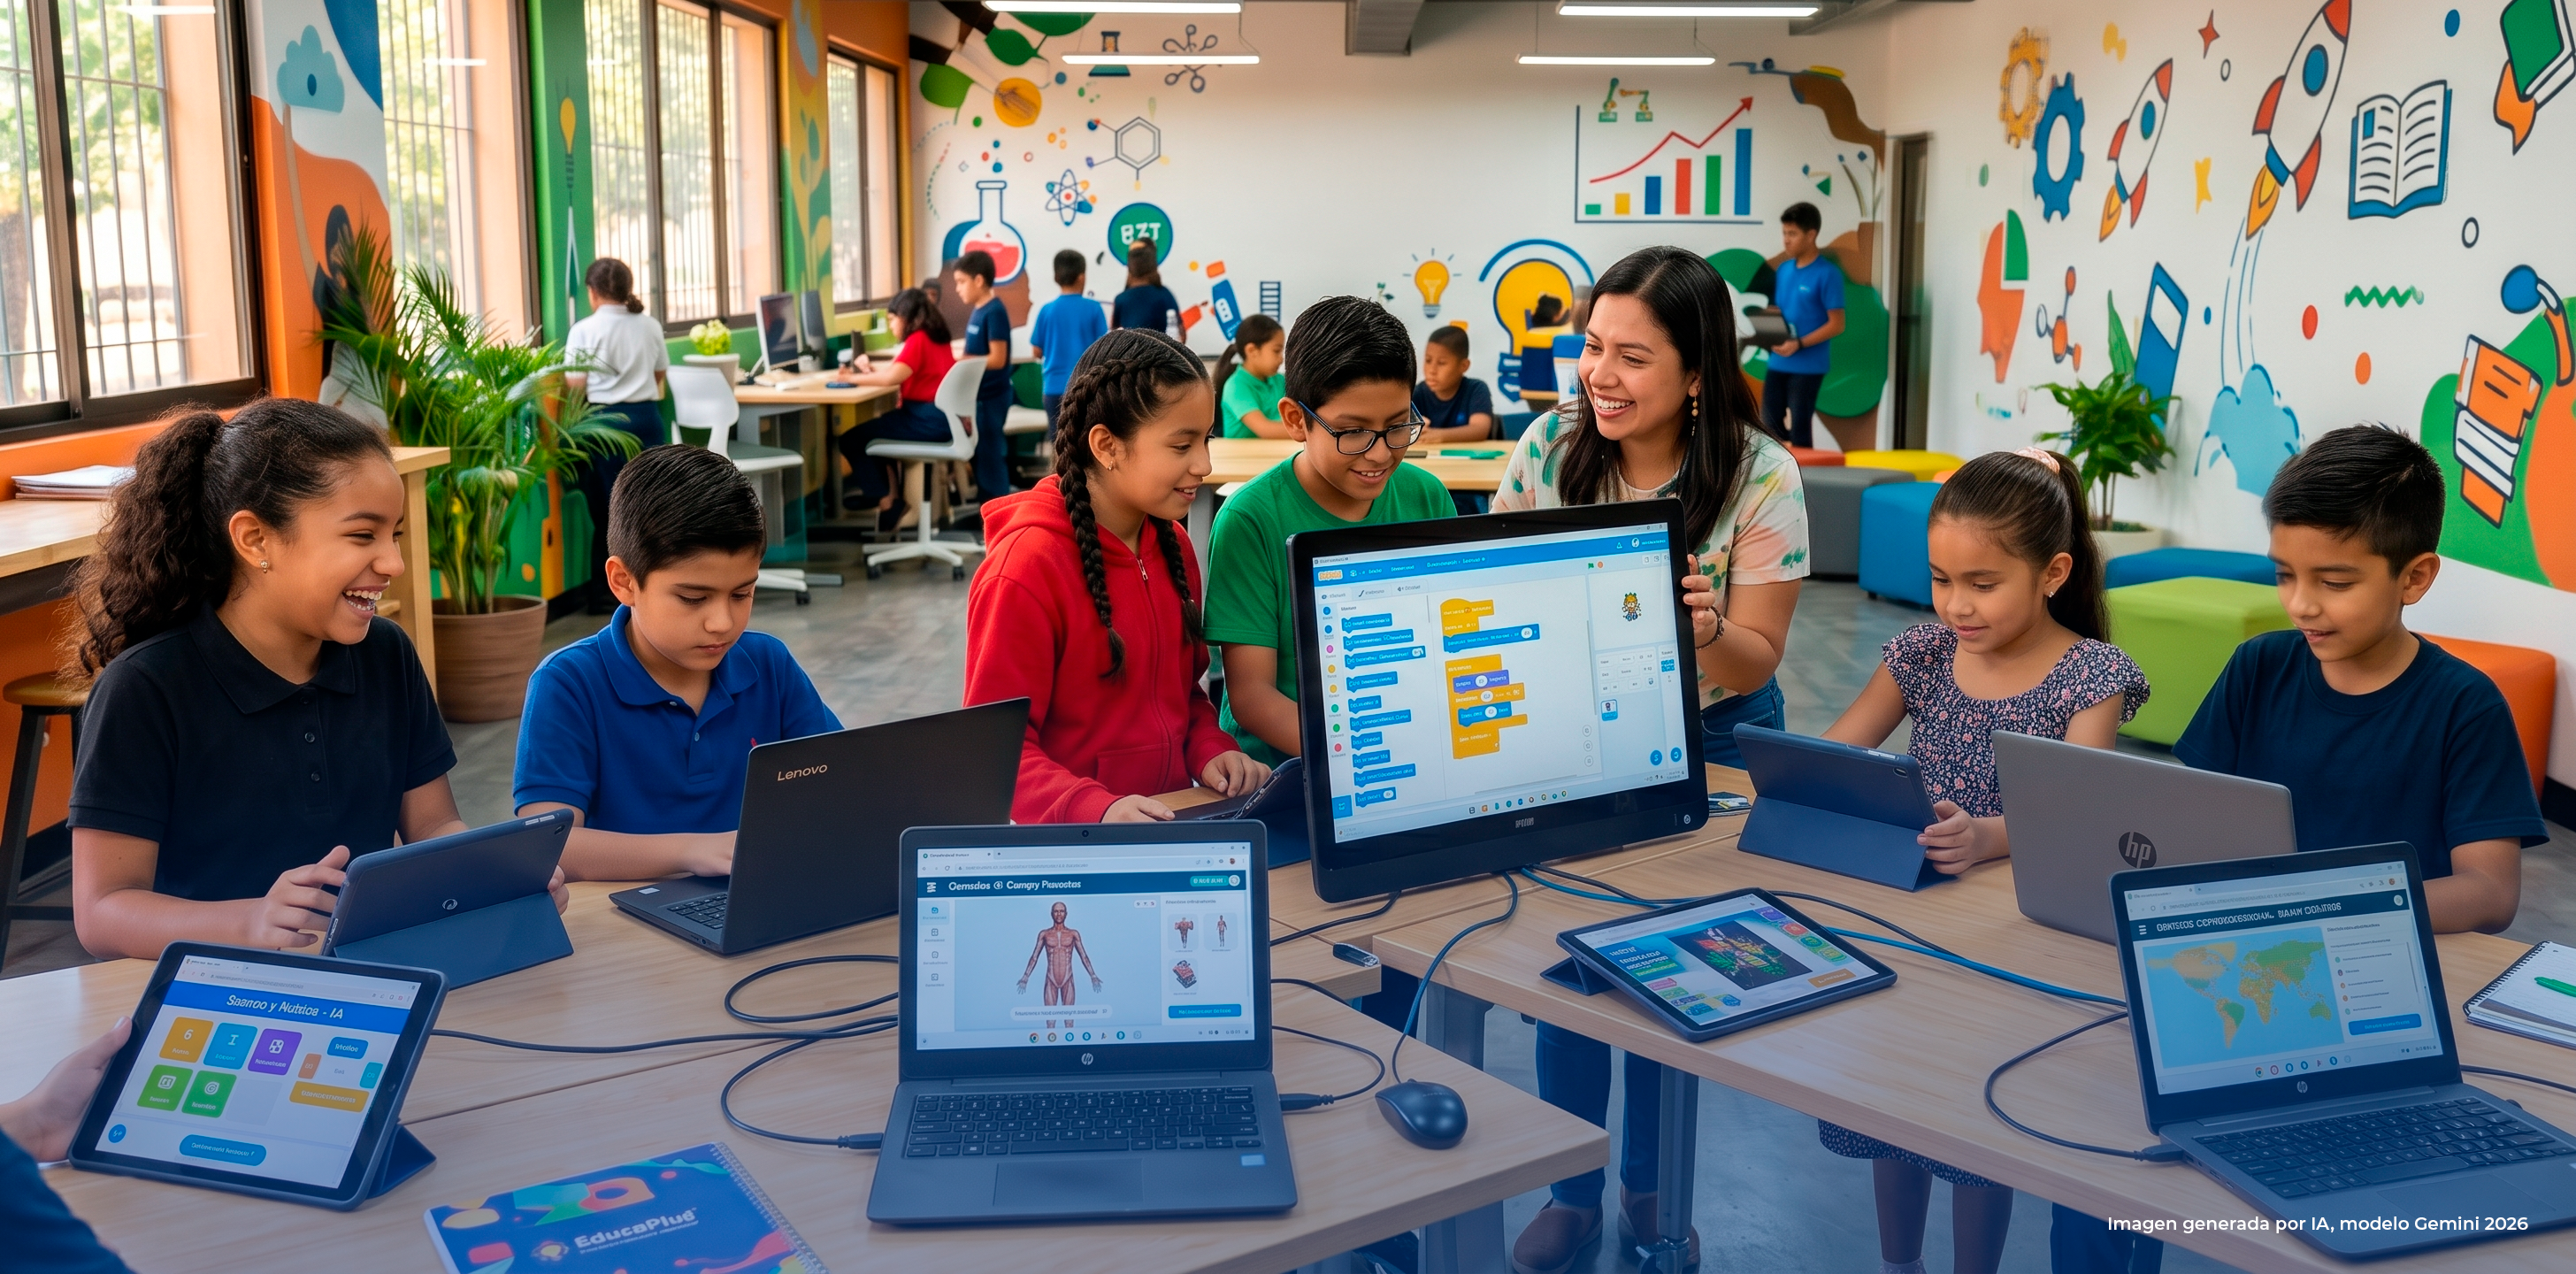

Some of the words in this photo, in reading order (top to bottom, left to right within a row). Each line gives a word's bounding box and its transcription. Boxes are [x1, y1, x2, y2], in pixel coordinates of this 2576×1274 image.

[778, 764, 828, 781] Lenovo
[2125, 832, 2151, 869] hp
[267, 1002, 277, 1013] y
[329, 1008, 343, 1019] IA
